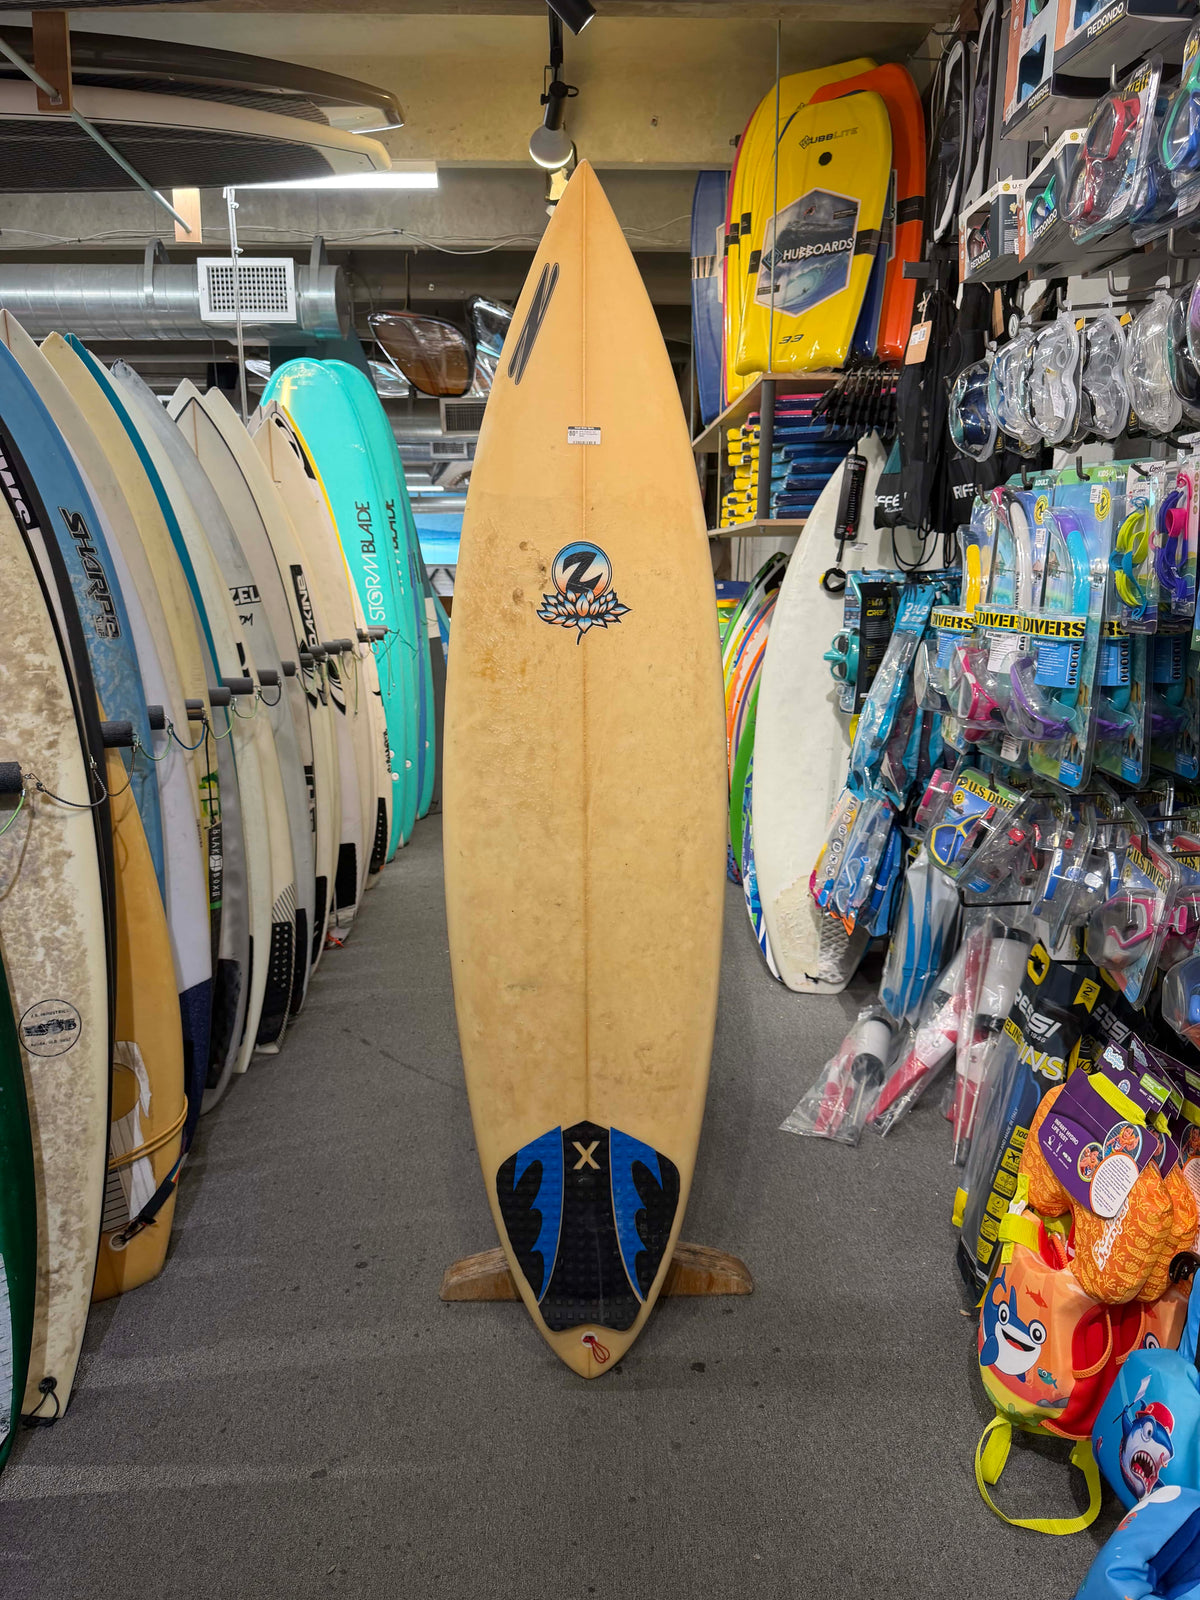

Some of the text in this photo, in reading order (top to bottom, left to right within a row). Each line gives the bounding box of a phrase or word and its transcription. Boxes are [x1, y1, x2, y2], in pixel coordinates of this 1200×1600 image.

[1087, 3, 1124, 38] REDONDO
[1032, 208, 1058, 242] REDONDO
[783, 238, 854, 261] HUBBOARDS
[779, 334, 805, 345] 33
[562, 551, 603, 594] Z
[1023, 618, 1085, 637] DIVERS
[968, 781, 1015, 810] U.S. DIVE
[1083, 986, 1094, 996] 2
[1014, 988, 1062, 1039] RESSI
